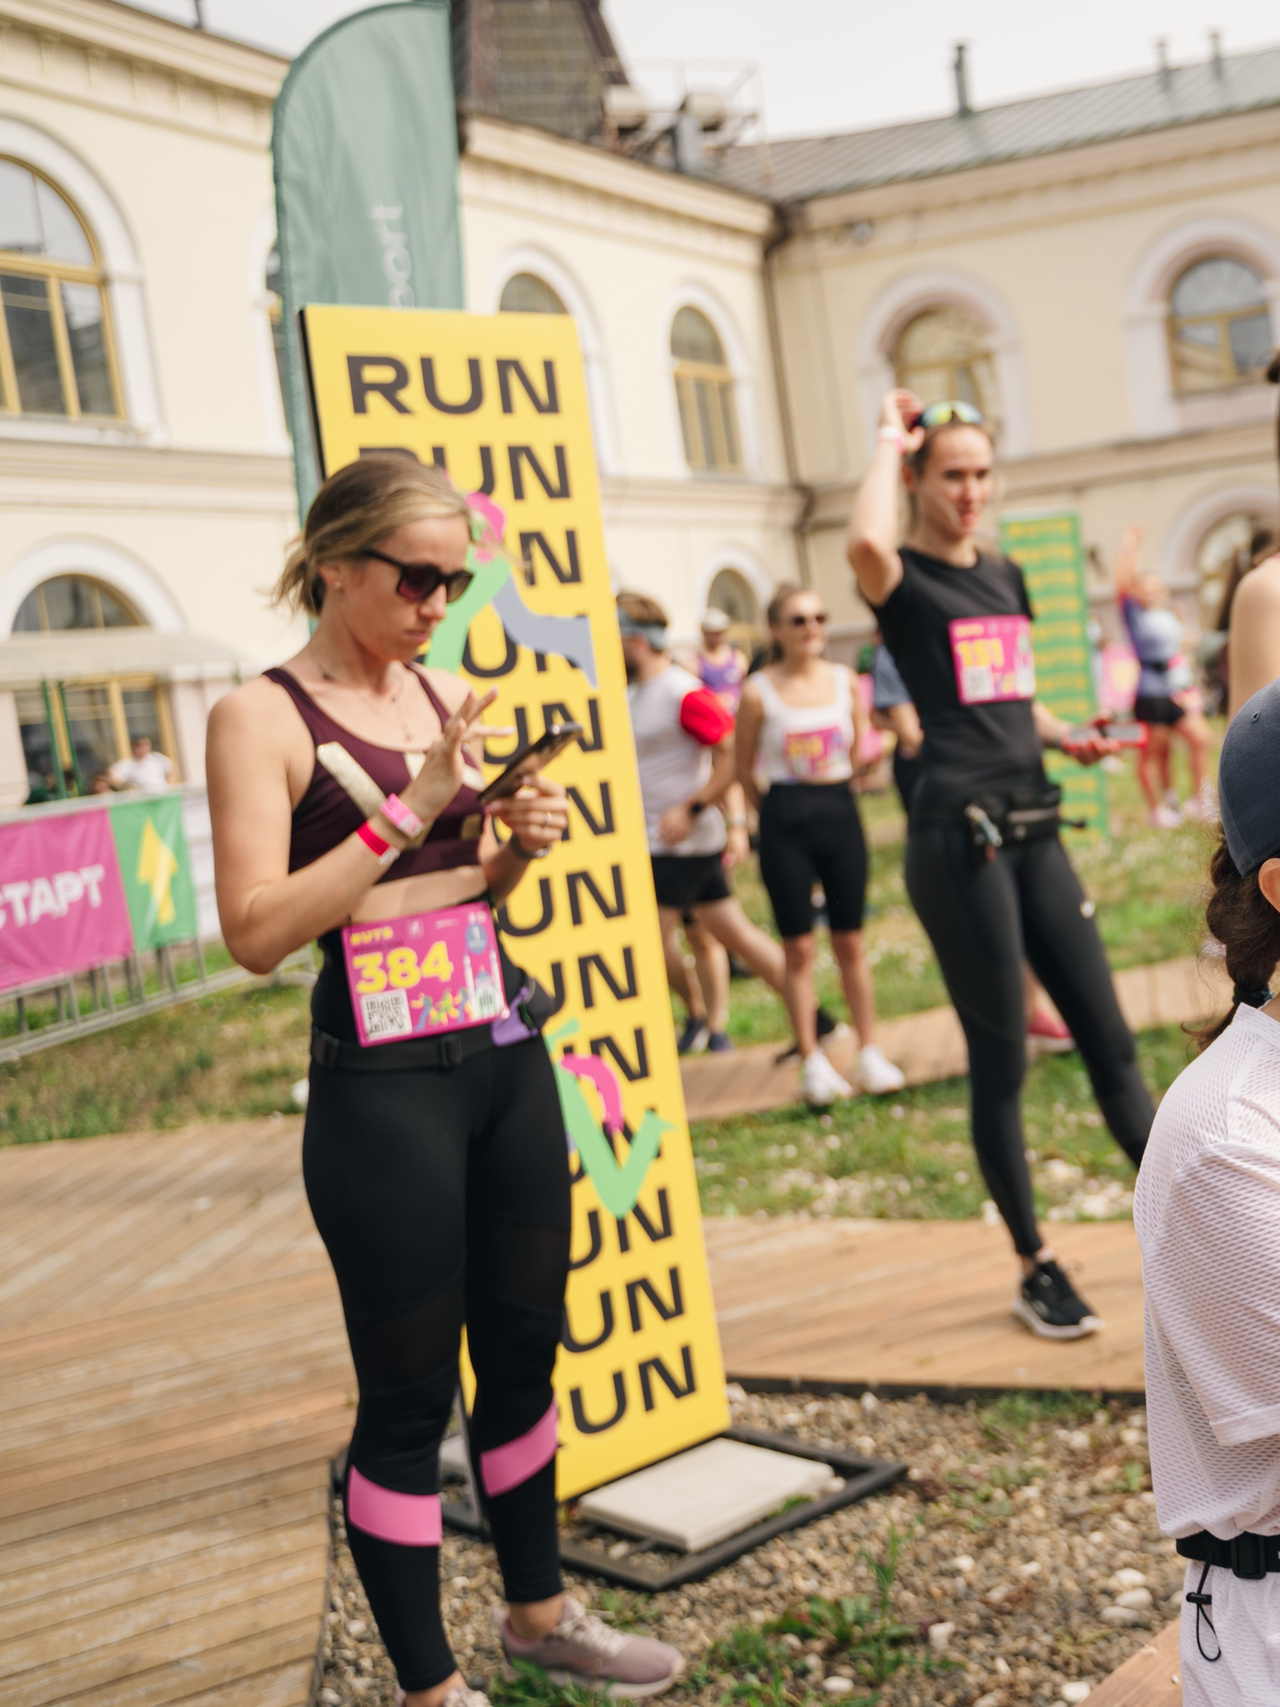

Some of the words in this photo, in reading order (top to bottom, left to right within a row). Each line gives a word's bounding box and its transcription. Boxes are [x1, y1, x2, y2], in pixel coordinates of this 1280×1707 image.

[346, 355, 560, 415] RUN
[358, 445, 571, 500] UN
[484, 697, 604, 765] UN
[501, 864, 627, 937] UN
[353, 940, 454, 993] 384
[562, 1264, 685, 1354] UN
[568, 1344, 697, 1435] UN
